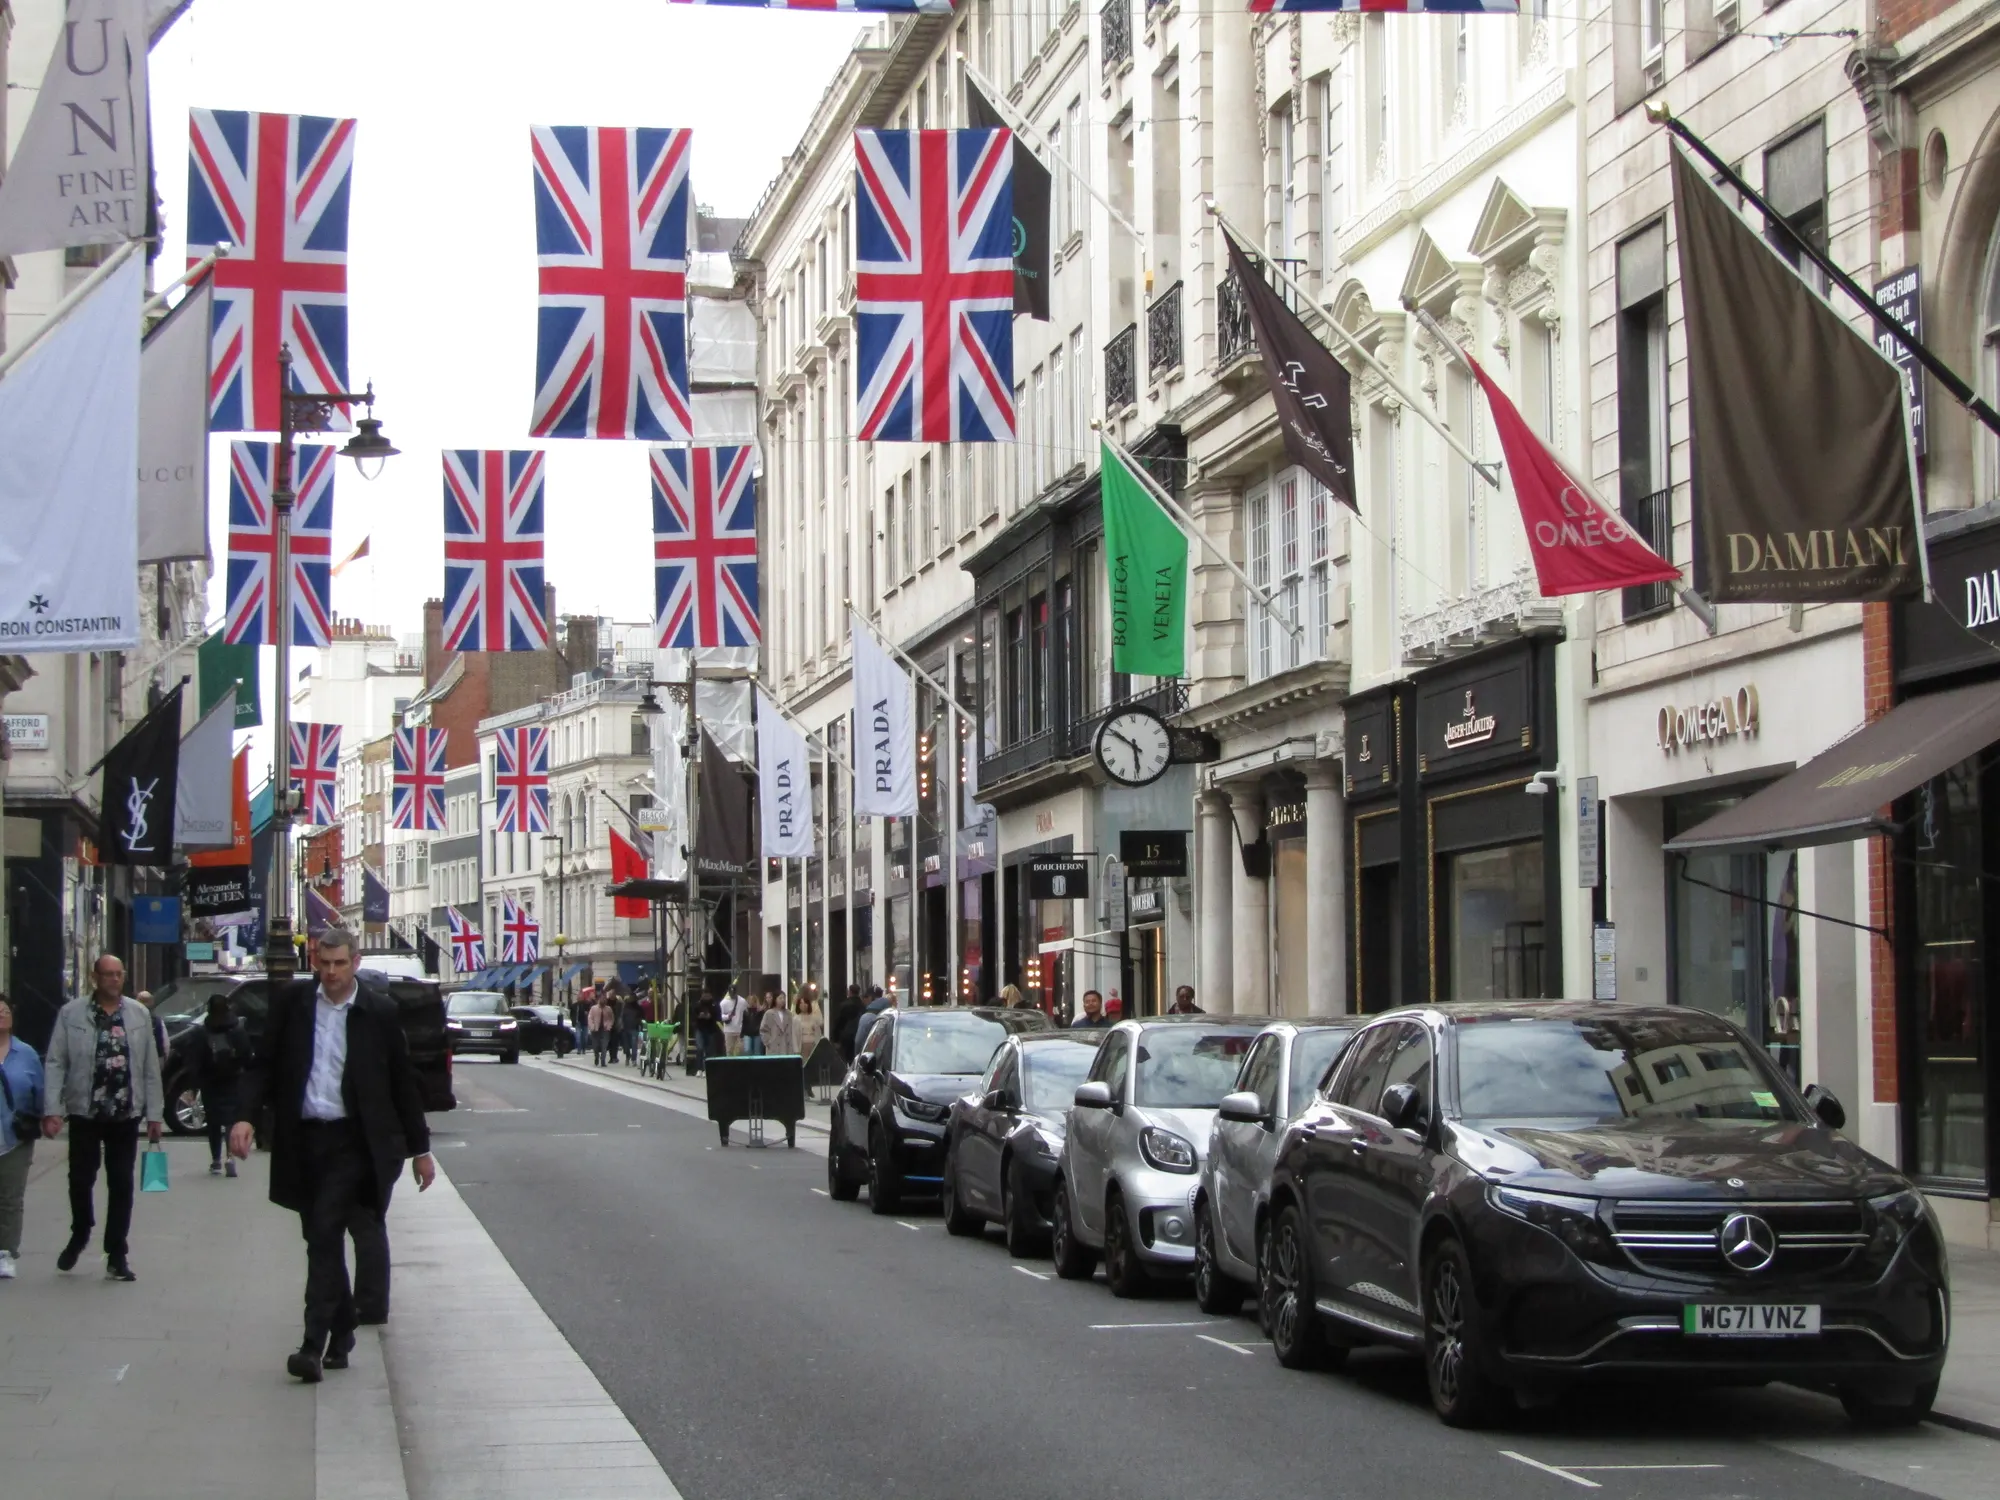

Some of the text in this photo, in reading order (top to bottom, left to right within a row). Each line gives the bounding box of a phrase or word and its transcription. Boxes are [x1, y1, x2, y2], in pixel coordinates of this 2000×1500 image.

[58, 168, 137, 197] FINE
[69, 199, 133, 227] ART
[1876, 273, 1917, 306] OFFICE FLOOR
[1535, 517, 1636, 548] OMEG
[1727, 527, 1908, 574] DAMIANI
[1113, 554, 1128, 647] BOTTEGA
[1729, 582, 1791, 591] HANDMADE
[1153, 566, 1172, 642] VENETA
[35, 616, 121, 635] CONSTANTIN
[1676, 698, 1733, 746] OMEGA
[873, 698, 892, 793] PRADA
[777, 759, 793, 838] PRADA
[698, 858, 743, 873] MaxMara
[1145, 844, 1161, 859] 15
[1033, 862, 1084, 872] BOUCHERON
[194, 890, 245, 906] McQUEEN
[196, 880, 242, 895] Alexander
[1131, 892, 1156, 912] BOUCHERON
[1702, 1306, 1806, 1329] WG71 VNZ
